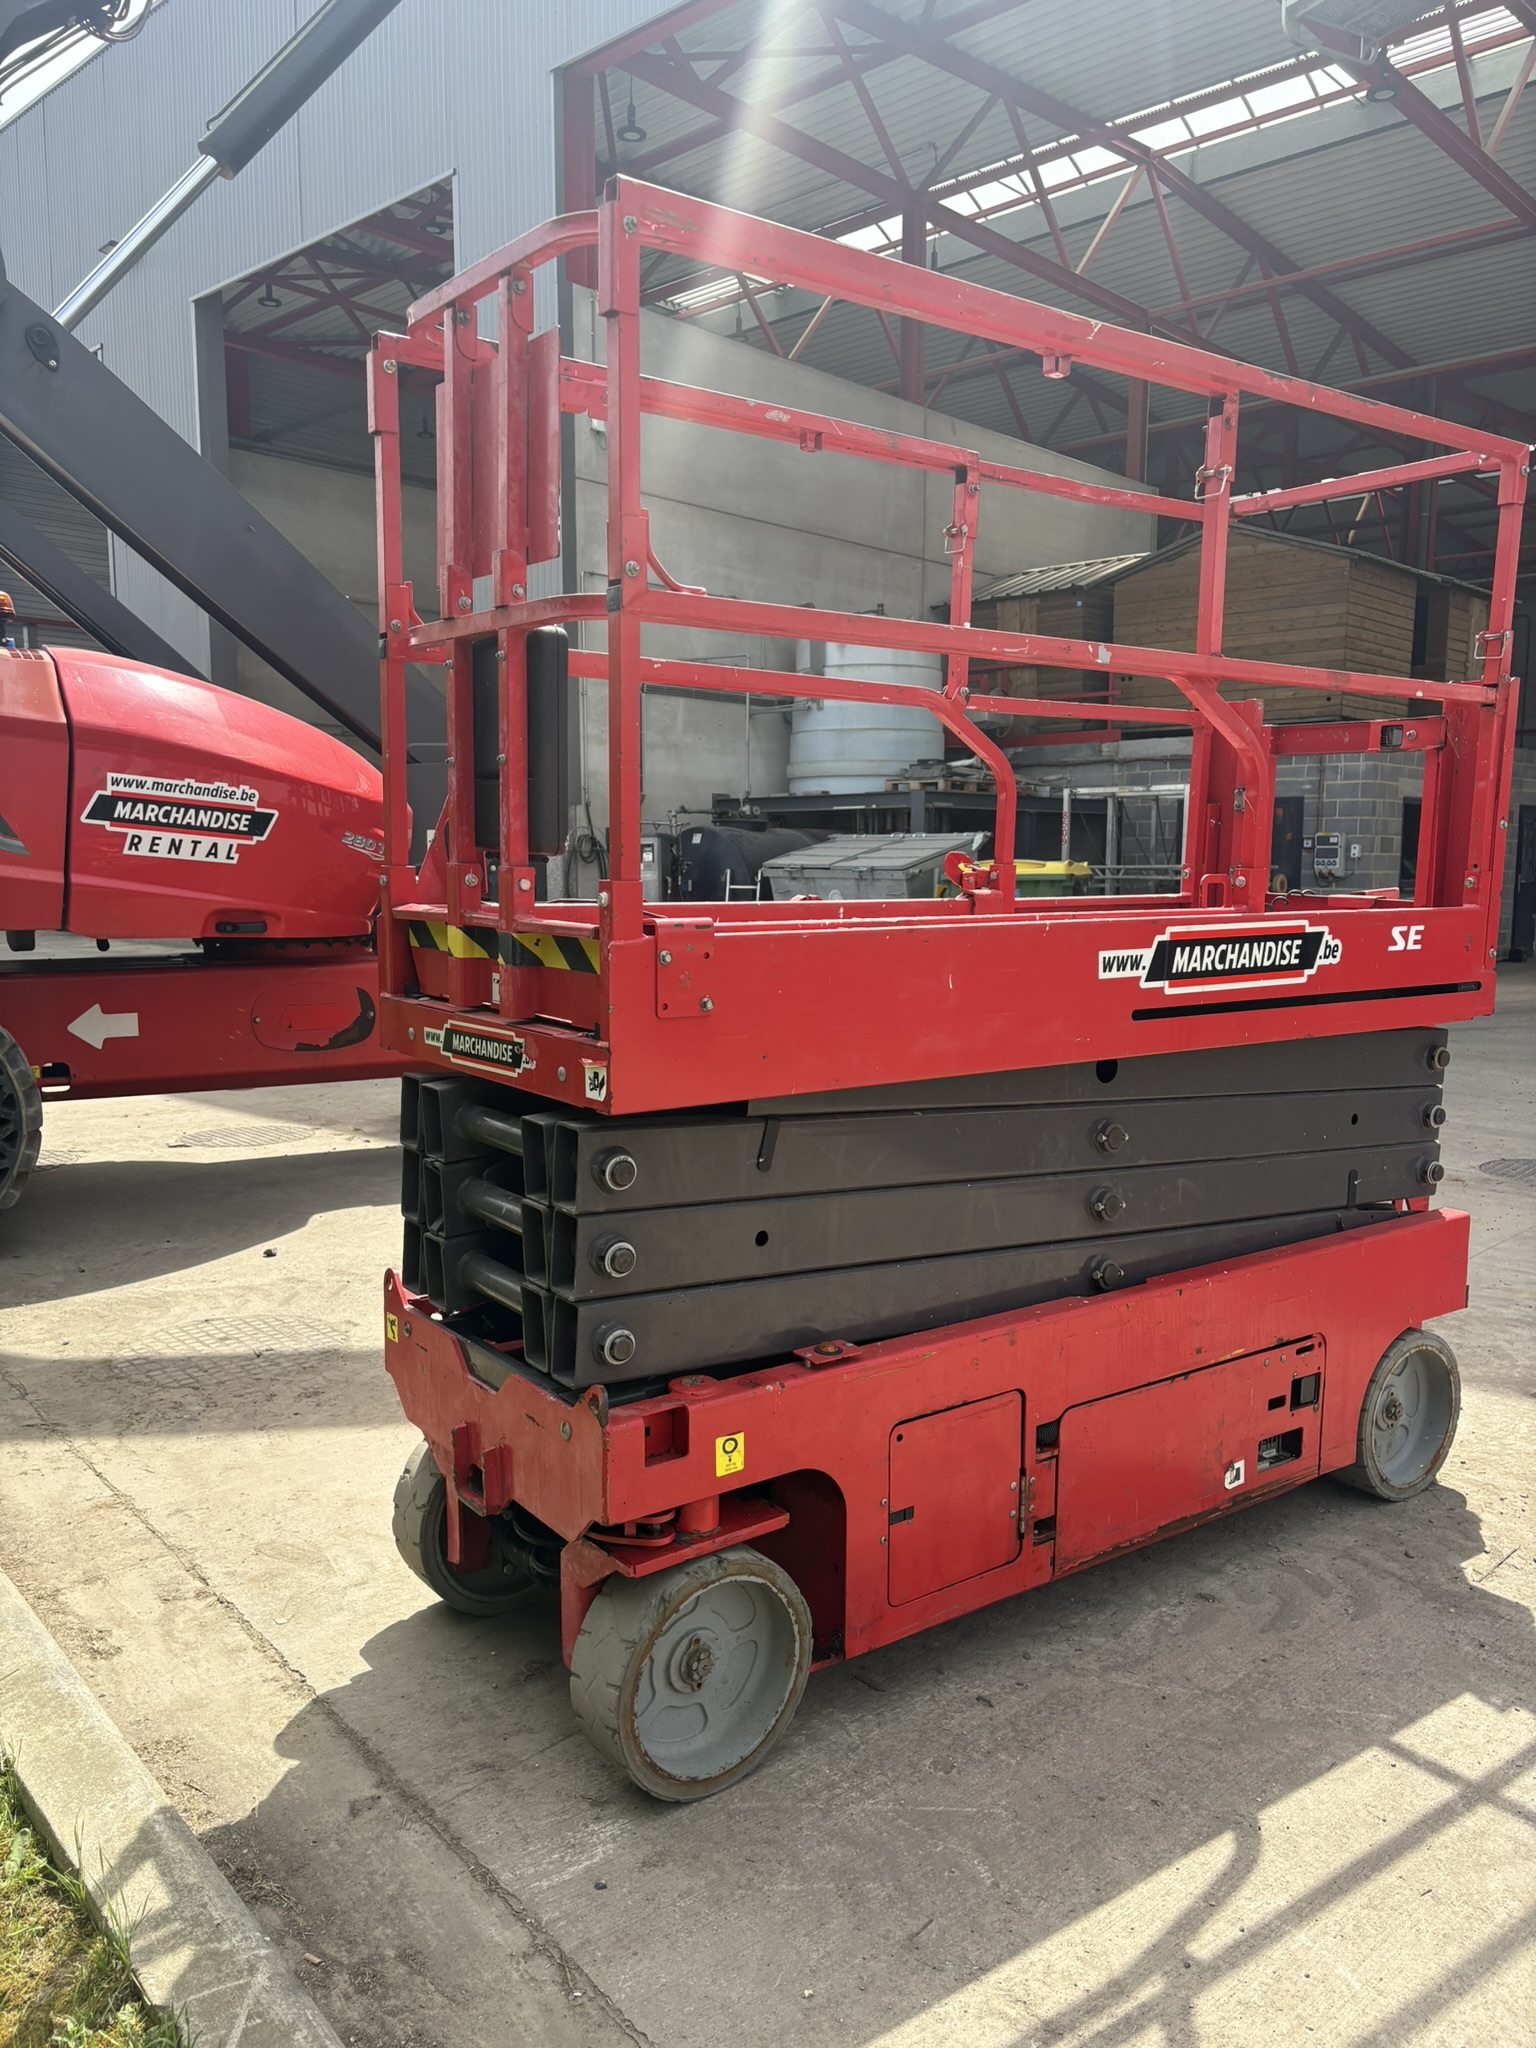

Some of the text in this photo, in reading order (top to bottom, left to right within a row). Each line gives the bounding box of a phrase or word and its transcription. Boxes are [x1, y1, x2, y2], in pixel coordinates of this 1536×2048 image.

[111, 776, 256, 802] www.marchandise.be
[113, 801, 252, 832] MARCHANDISE
[127, 834, 236, 860] RENTAL
[1387, 925, 1425, 952] SE
[1172, 939, 1303, 974] MARCHANDISE
[452, 1033, 513, 1062] MARCHANDISE
